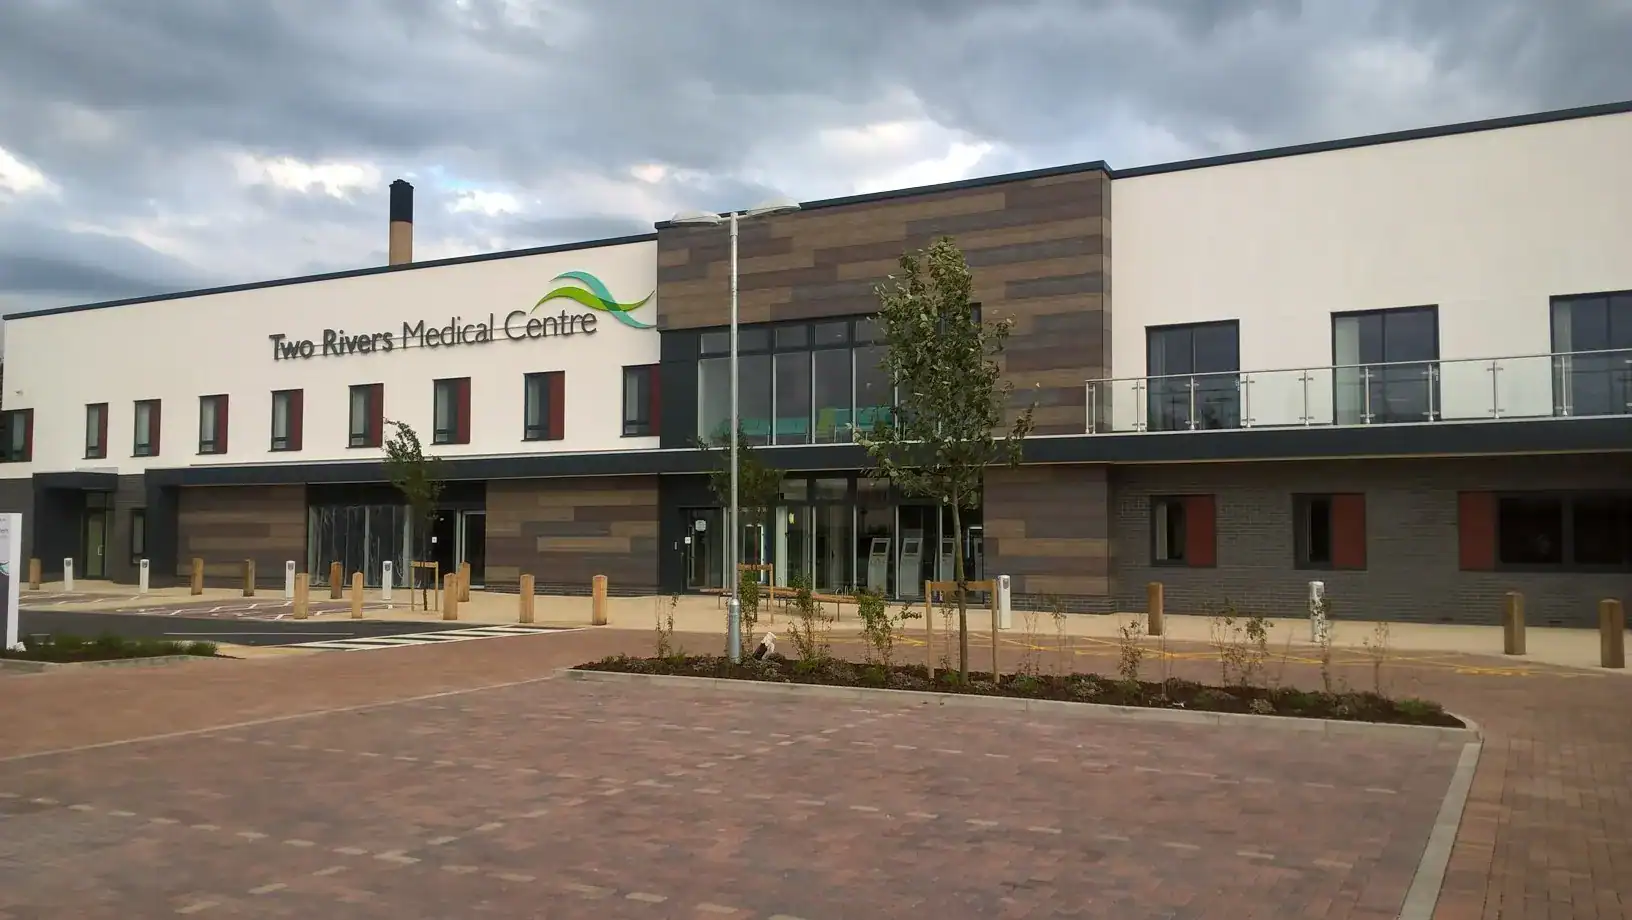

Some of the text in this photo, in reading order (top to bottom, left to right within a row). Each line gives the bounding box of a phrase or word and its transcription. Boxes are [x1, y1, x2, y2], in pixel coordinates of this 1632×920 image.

[269, 309, 597, 361] Two Rivers Medical Centre
